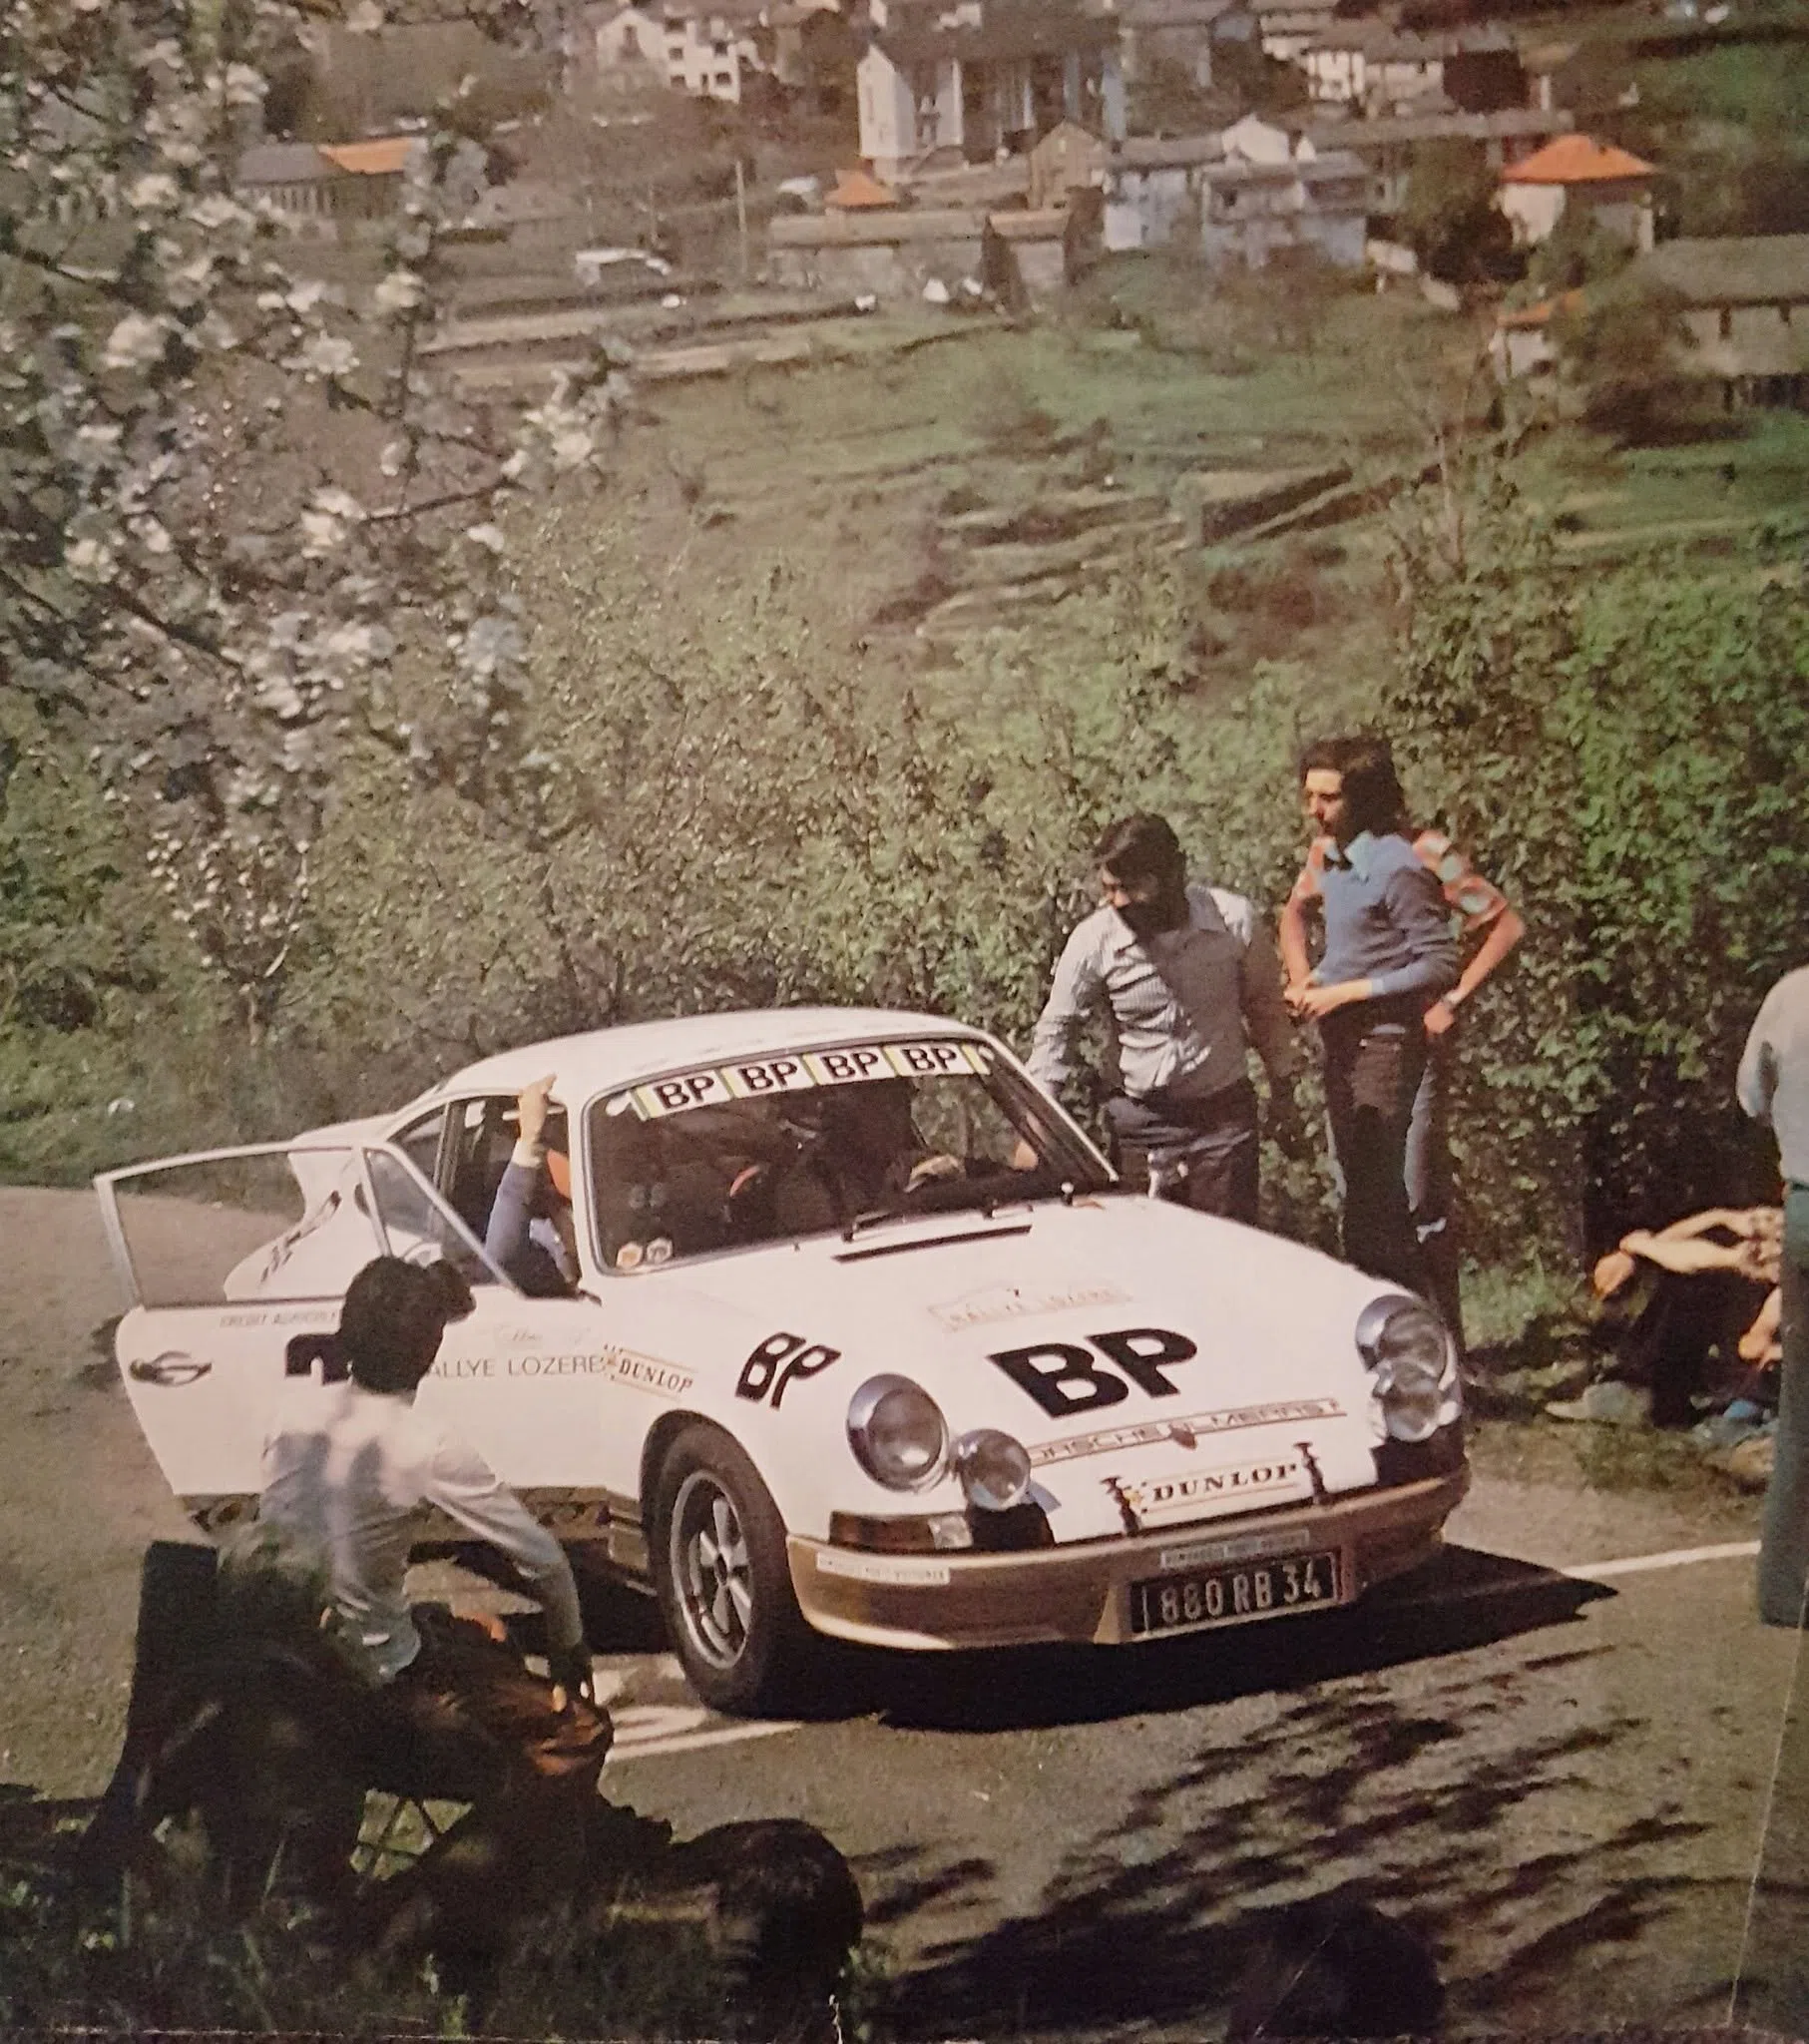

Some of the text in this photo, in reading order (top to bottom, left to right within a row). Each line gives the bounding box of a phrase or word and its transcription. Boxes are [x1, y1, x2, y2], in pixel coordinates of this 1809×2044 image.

[654, 1048, 957, 1109] BP BP BP BP
[426, 1357, 496, 1381] ALLYE
[618, 1356, 693, 1393] DUNLOP
[734, 1331, 841, 1412] BP
[986, 1327, 1197, 1419] BP
[1152, 1463, 1297, 1501] DUNLOP
[1233, 1571, 1272, 1613] RB
[1283, 1558, 1321, 1603] 34
